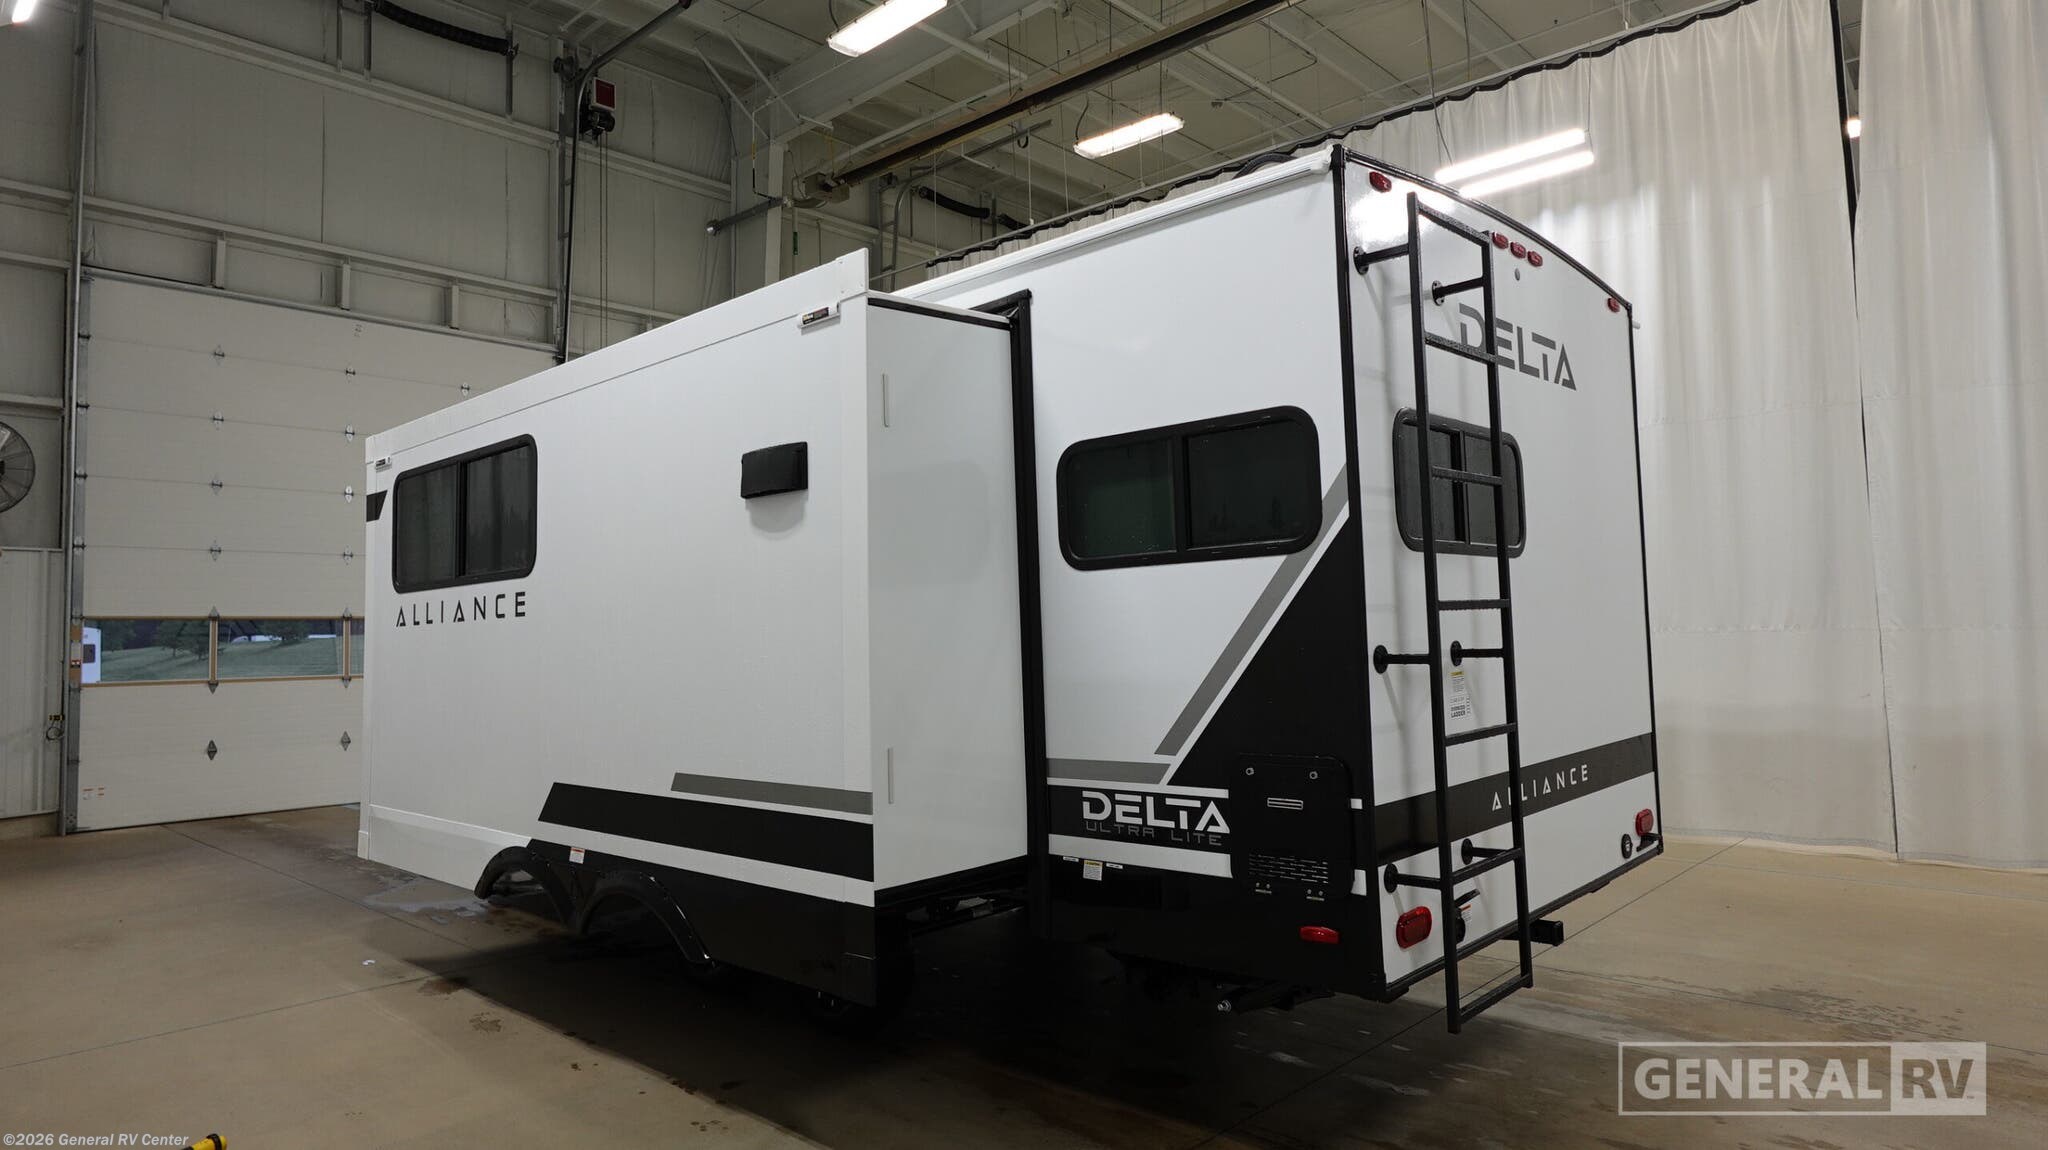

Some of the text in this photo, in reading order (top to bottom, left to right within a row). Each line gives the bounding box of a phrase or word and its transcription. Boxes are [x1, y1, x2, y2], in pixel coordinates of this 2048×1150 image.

[1459, 303, 1577, 391] DELTA
[396, 591, 526, 627] ALLIANCE
[1082, 790, 1230, 834] DELTA
[1086, 821, 1222, 846] ULTRA LITE
